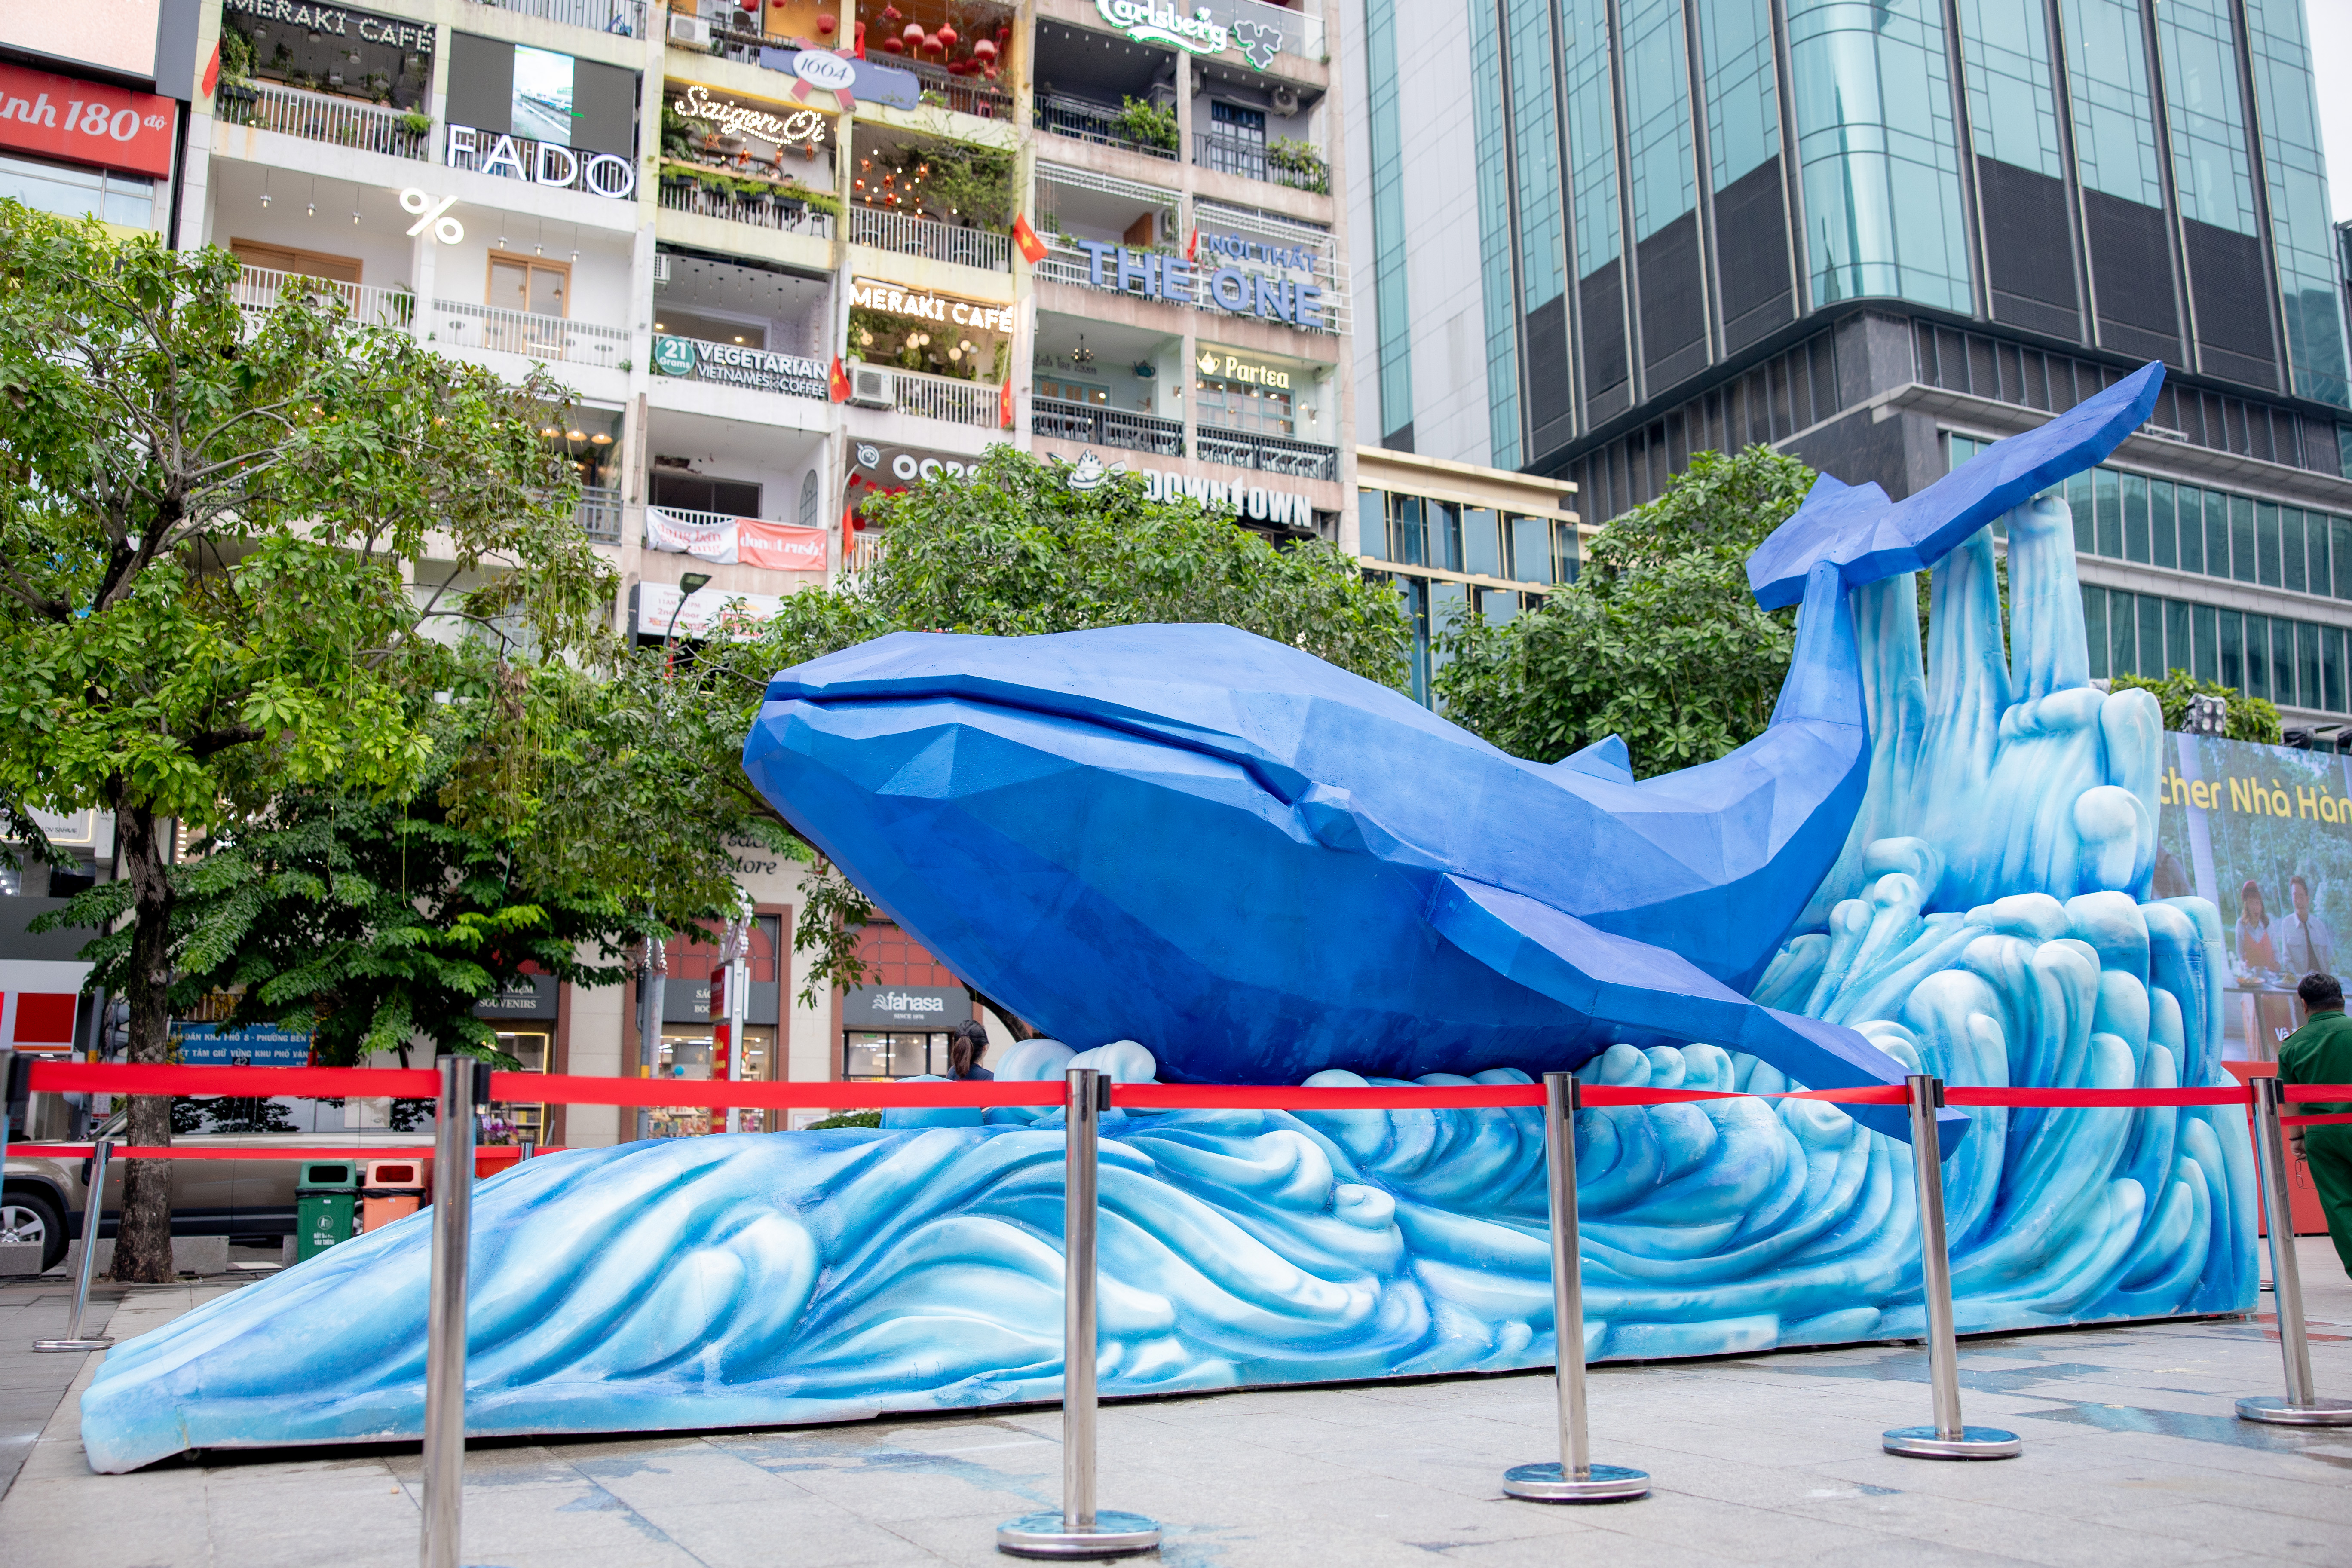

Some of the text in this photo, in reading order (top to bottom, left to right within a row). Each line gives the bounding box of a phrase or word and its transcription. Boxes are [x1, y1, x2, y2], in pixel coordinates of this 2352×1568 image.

[358, 17, 433, 53] CAFÉ
[1095, 0, 1228, 54] Carlsberg
[801, 57, 851, 80] 1664
[64, 100, 140, 141] 180
[448, 124, 635, 199] FADO
[1208, 233, 1317, 273] NỘI THẤT
[1077, 239, 1323, 328] THE ONE
[848, 284, 1014, 334] MERAKI CAFÉ
[659, 356, 690, 370] Grams
[665, 339, 686, 360] 21
[697, 342, 829, 381] VEGETARIAN
[779, 377, 826, 398] COFFEE
[1225, 355, 1290, 390] Partea
[2229, 777, 2291, 818] Nhà
[887, 991, 944, 1012] fahasa
[233, 1057, 248, 1066] 42
[254, 1050, 272, 1058] KHU
